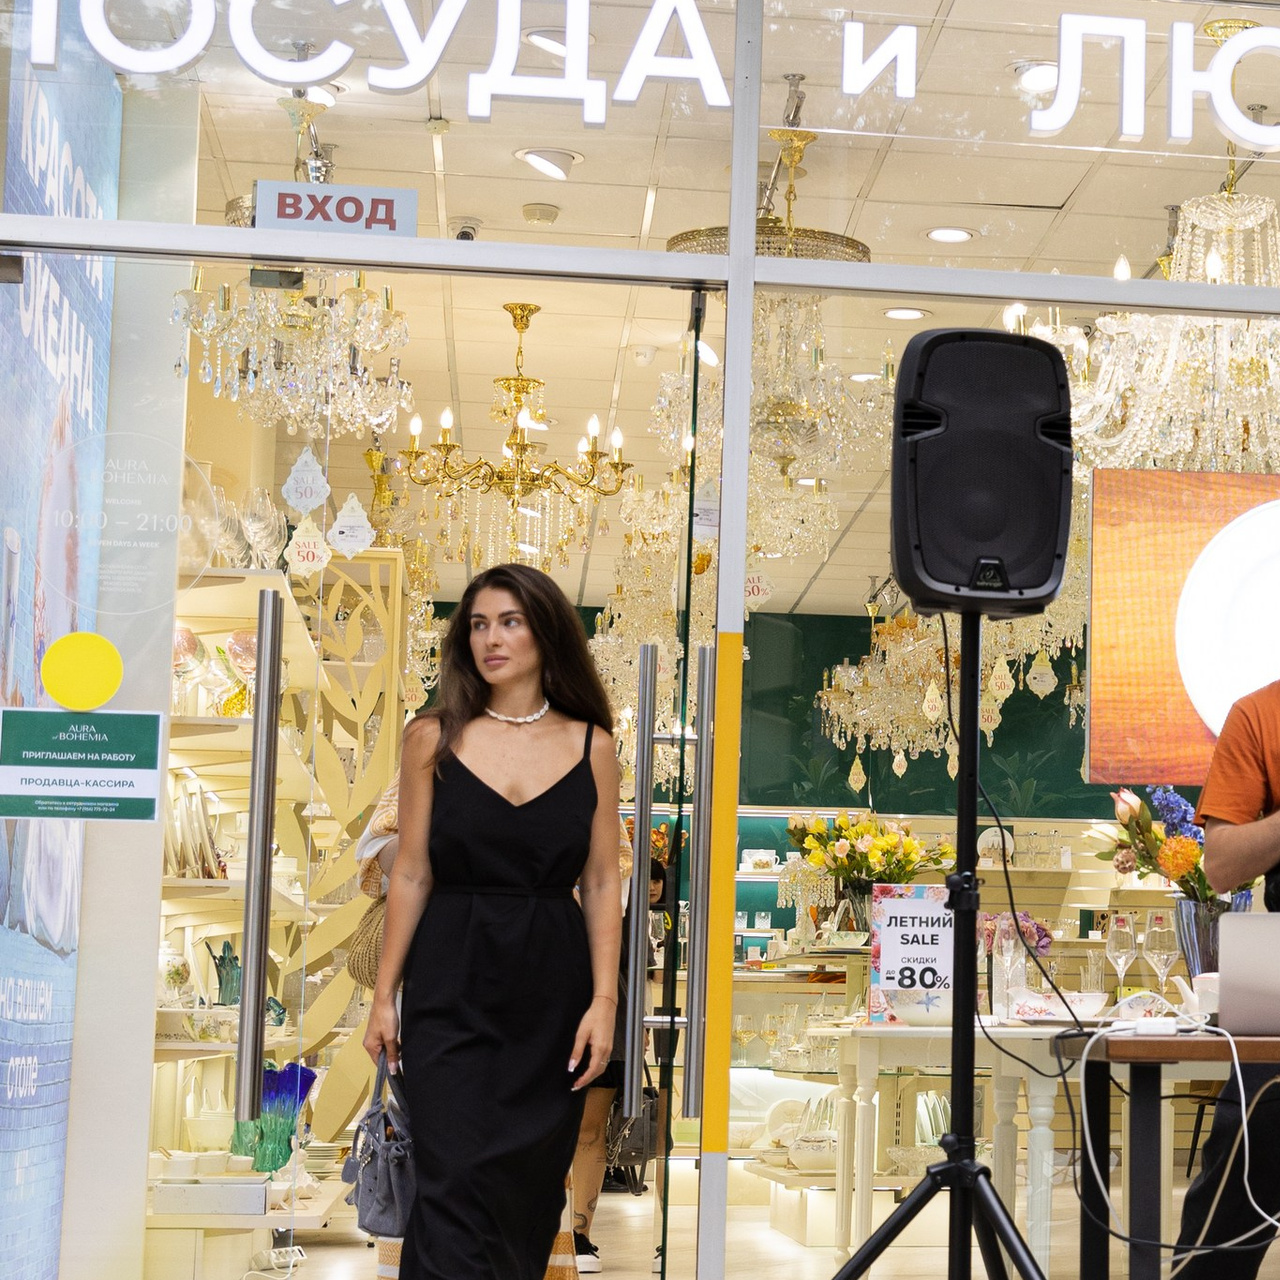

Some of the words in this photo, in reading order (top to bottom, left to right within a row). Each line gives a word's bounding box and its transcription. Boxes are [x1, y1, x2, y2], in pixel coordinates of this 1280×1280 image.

[277, 189, 397, 231] ВХОД
[104, 458, 150, 472] AURA
[90, 471, 169, 485] OHEMIA
[293, 477, 317, 486] SALE
[105, 498, 143, 506] WELCOME
[136, 512, 193, 533] 21:00
[295, 541, 320, 550] SALE
[297, 550, 324, 563] 50%
[68, 724, 97, 733] AURA
[59, 732, 109, 742] BOHEMIA
[22, 750, 86, 761] ПРИГЛАШАЕМ
[87, 753, 100, 761] НА
[101, 754, 136, 762] РАБОТУ
[20, 777, 136, 789] ПРОДАВЦА-КАССИРА
[887, 912, 953, 929] ЛЕТНИЙ
[900, 933, 940, 946] SALE
[885, 966, 950, 990] -80%
